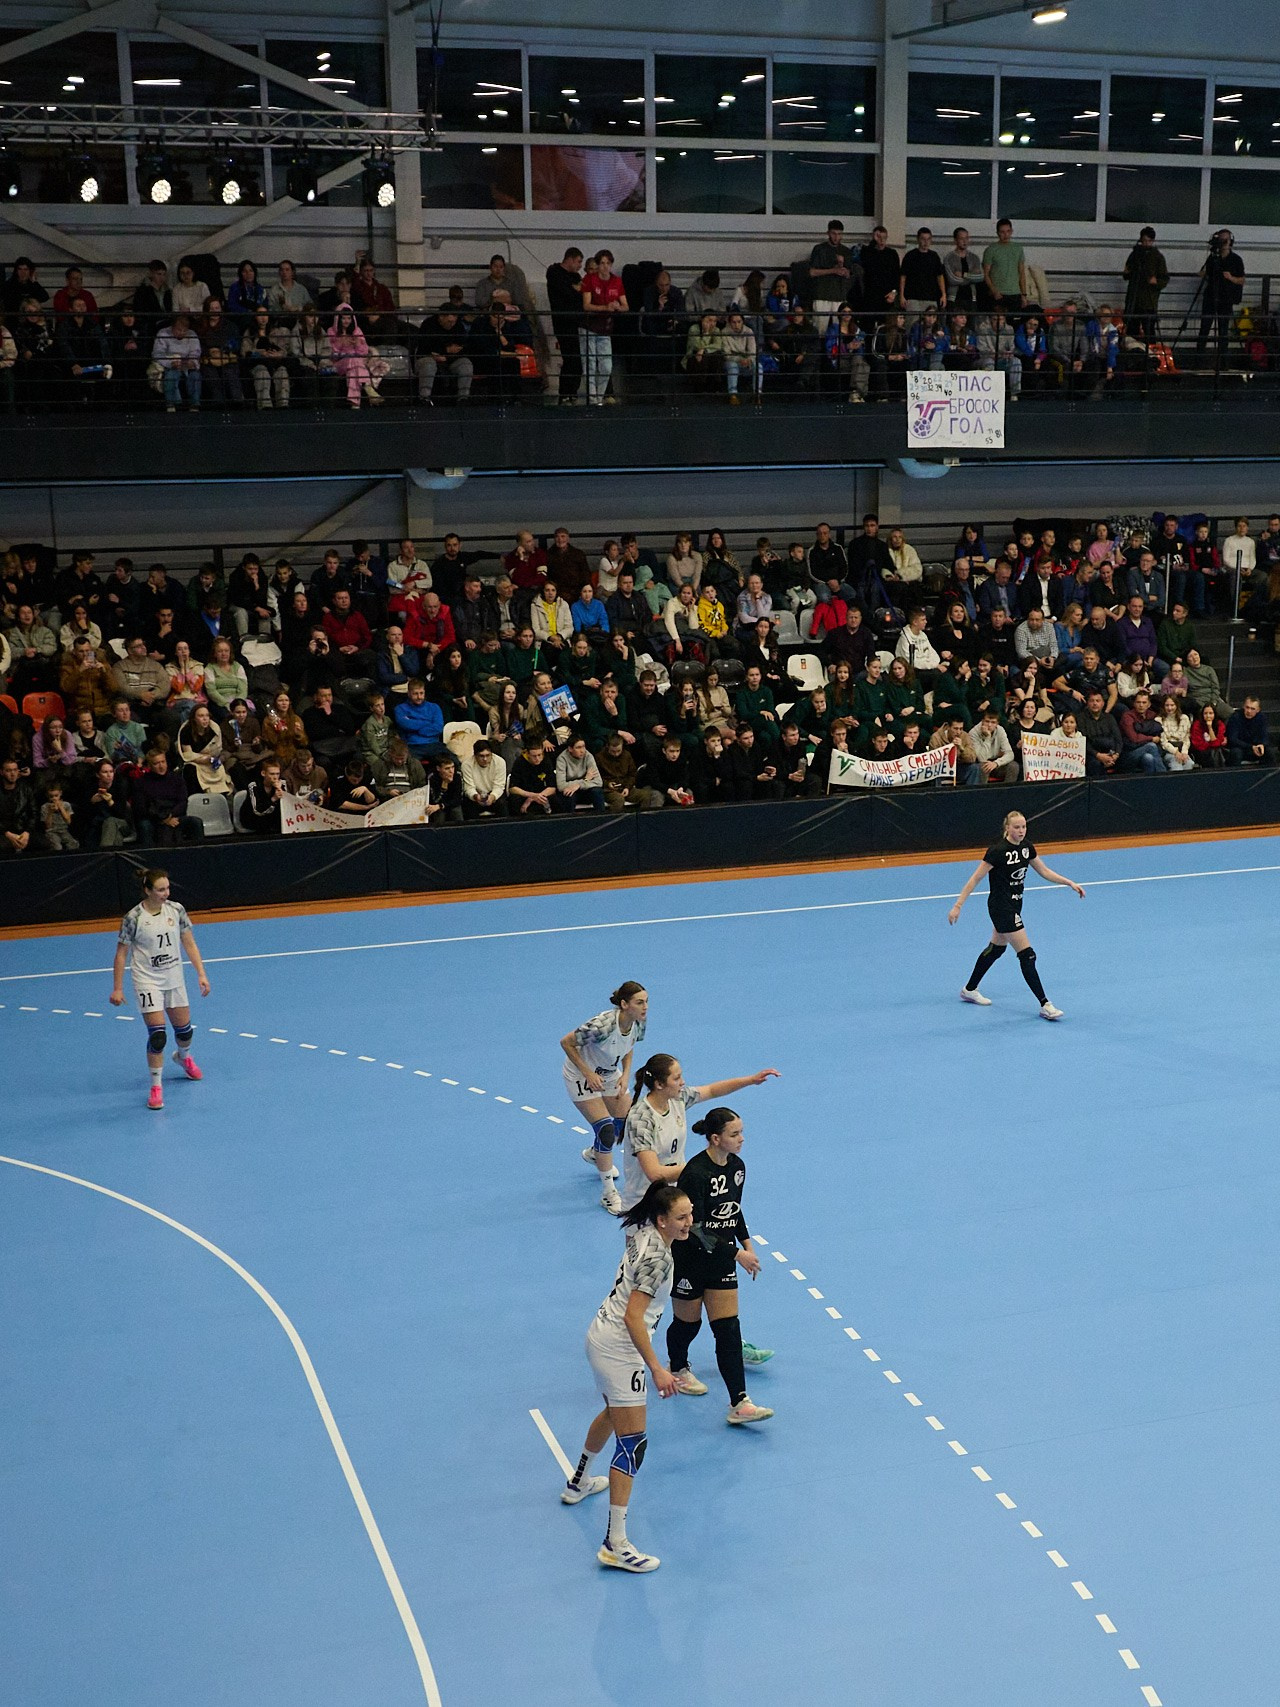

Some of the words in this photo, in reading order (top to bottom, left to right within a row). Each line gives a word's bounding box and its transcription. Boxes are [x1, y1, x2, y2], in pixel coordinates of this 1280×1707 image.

[958, 375, 992, 392] ПАС
[949, 398, 999, 414] БРОСОК
[949, 416, 984, 434] ГОЛ
[1005, 850, 1021, 865] 22
[157, 932, 172, 949] 71
[139, 992, 154, 1008] 71
[671, 1138, 678, 1154] 8
[710, 1174, 729, 1197] 32
